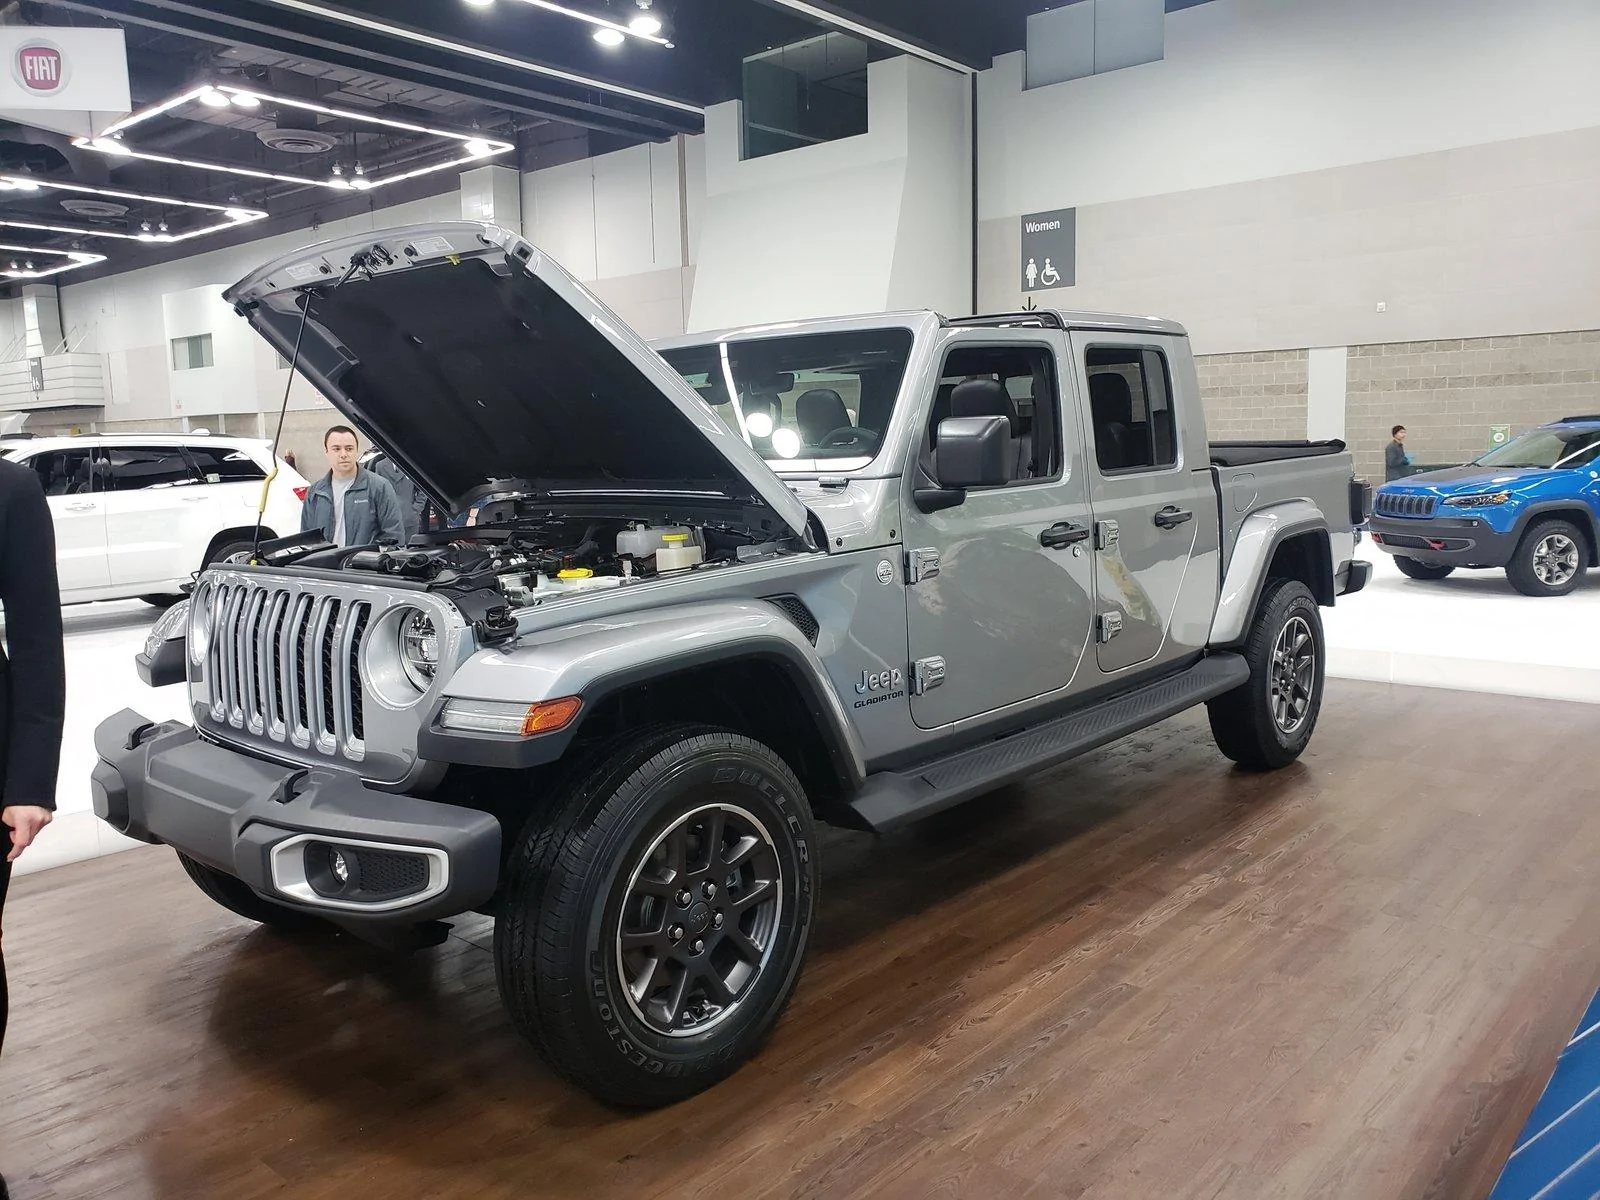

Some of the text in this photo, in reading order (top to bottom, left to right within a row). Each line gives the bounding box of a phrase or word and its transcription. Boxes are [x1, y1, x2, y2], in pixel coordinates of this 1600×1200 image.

[24, 55, 58, 80] FIAT
[1025, 220, 1061, 233] Women
[854, 668, 902, 694] Jeep
[853, 690, 904, 709] GLADIATOR
